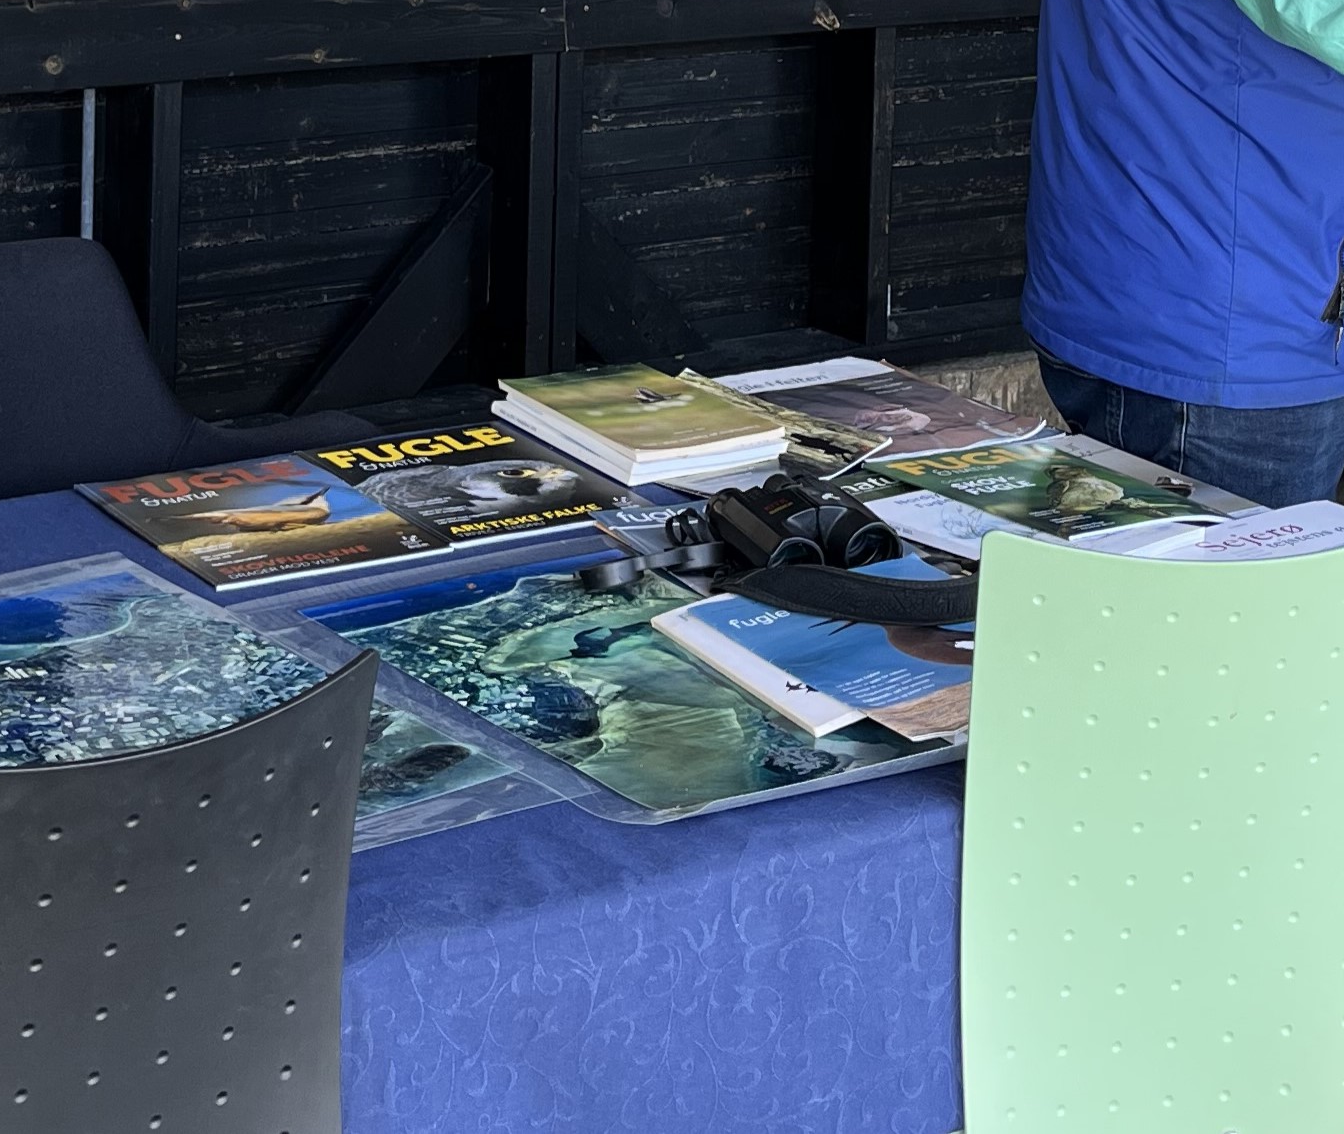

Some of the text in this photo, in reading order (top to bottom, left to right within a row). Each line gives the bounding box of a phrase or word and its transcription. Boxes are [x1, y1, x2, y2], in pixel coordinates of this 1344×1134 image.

[318, 426, 516, 470] FUGLE
[100, 460, 312, 504] FUGLE
[965, 480, 1037, 497] FUGLE
[450, 511, 540, 535] ARKTISKE
[541, 502, 603, 520] FALKE
[1195, 523, 1304, 554] Sejerø
[217, 543, 370, 577] SKOVFUGLENE
